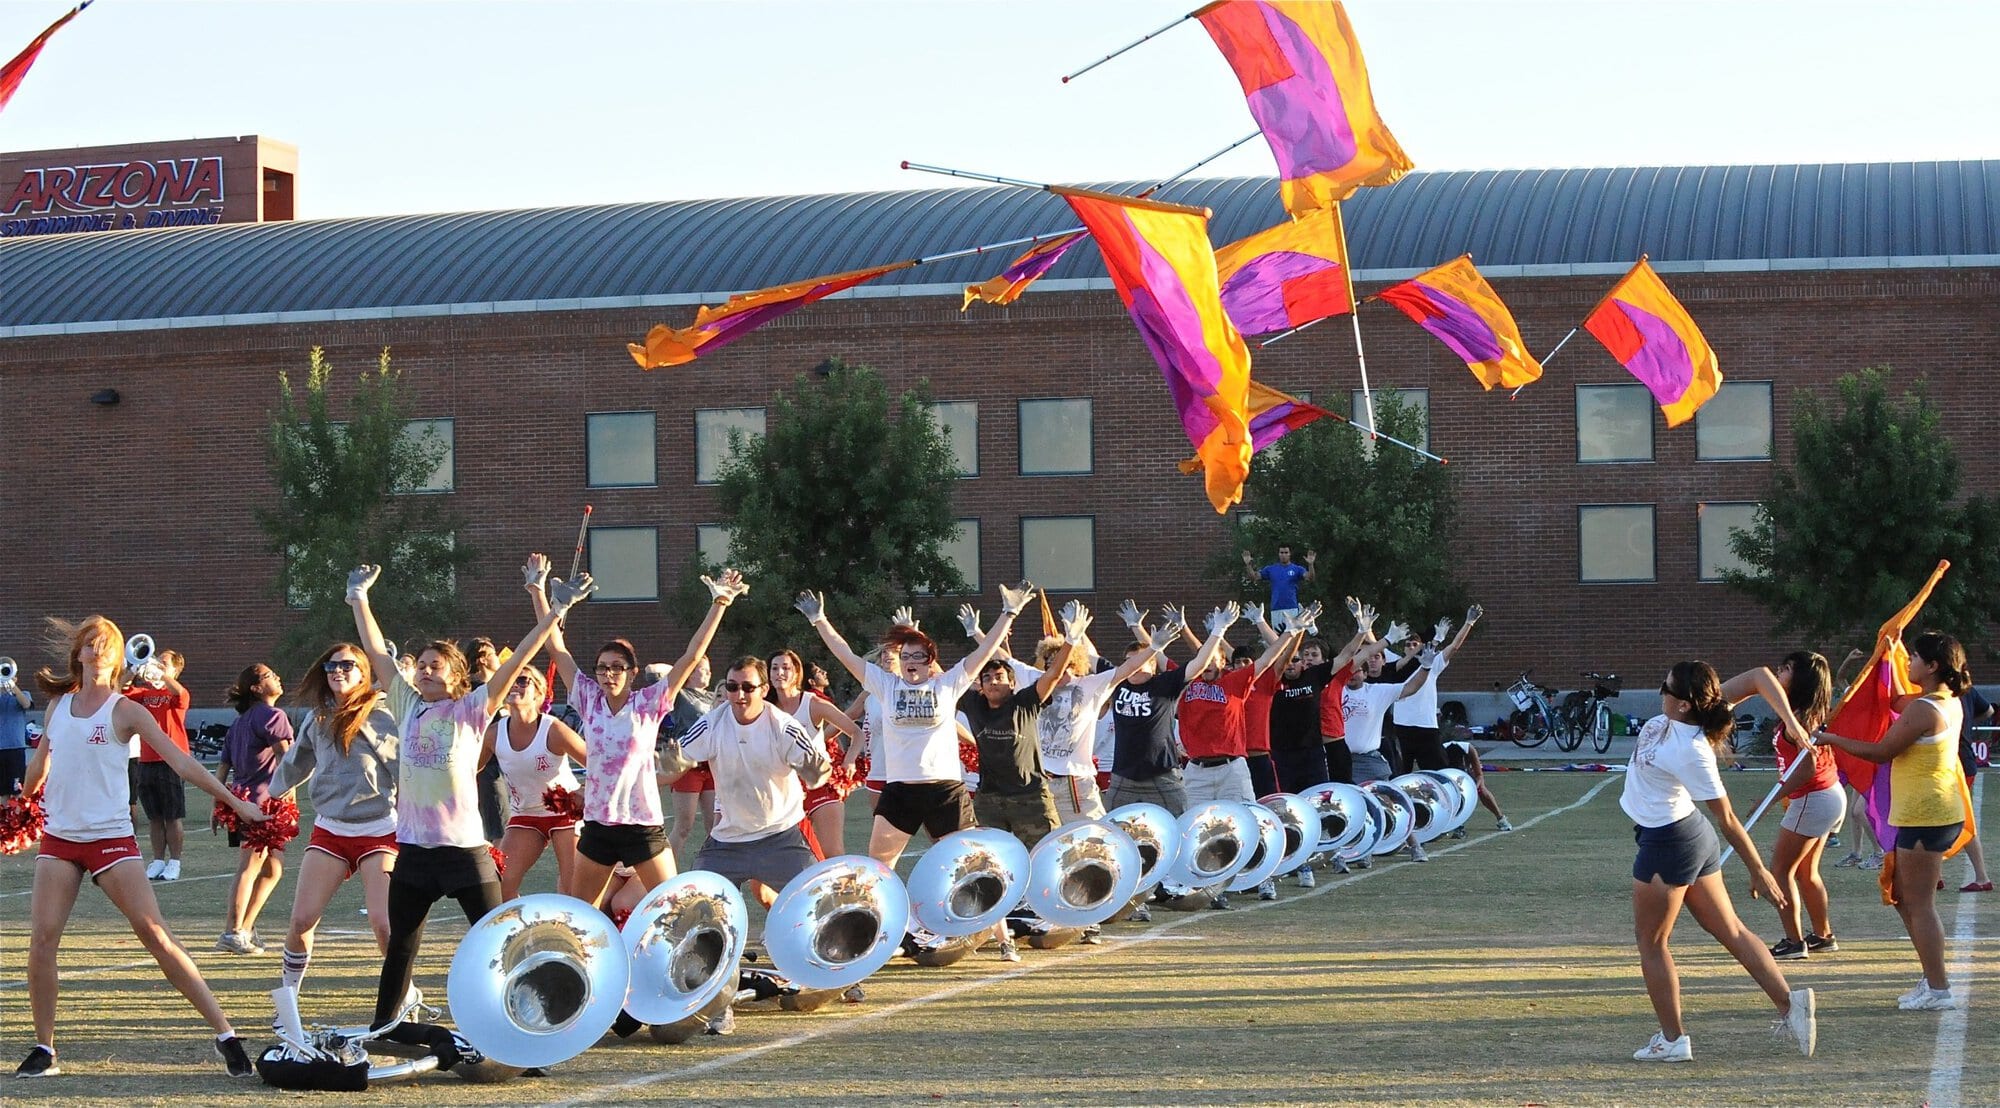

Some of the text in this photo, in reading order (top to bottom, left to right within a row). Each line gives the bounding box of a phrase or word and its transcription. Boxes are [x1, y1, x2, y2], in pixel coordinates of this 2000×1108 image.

[0, 156, 224, 216] ARIZONA
[0, 206, 224, 237] SWIMMING & DIVING
[1115, 700, 1152, 717] CATS
[87, 724, 108, 745] A
